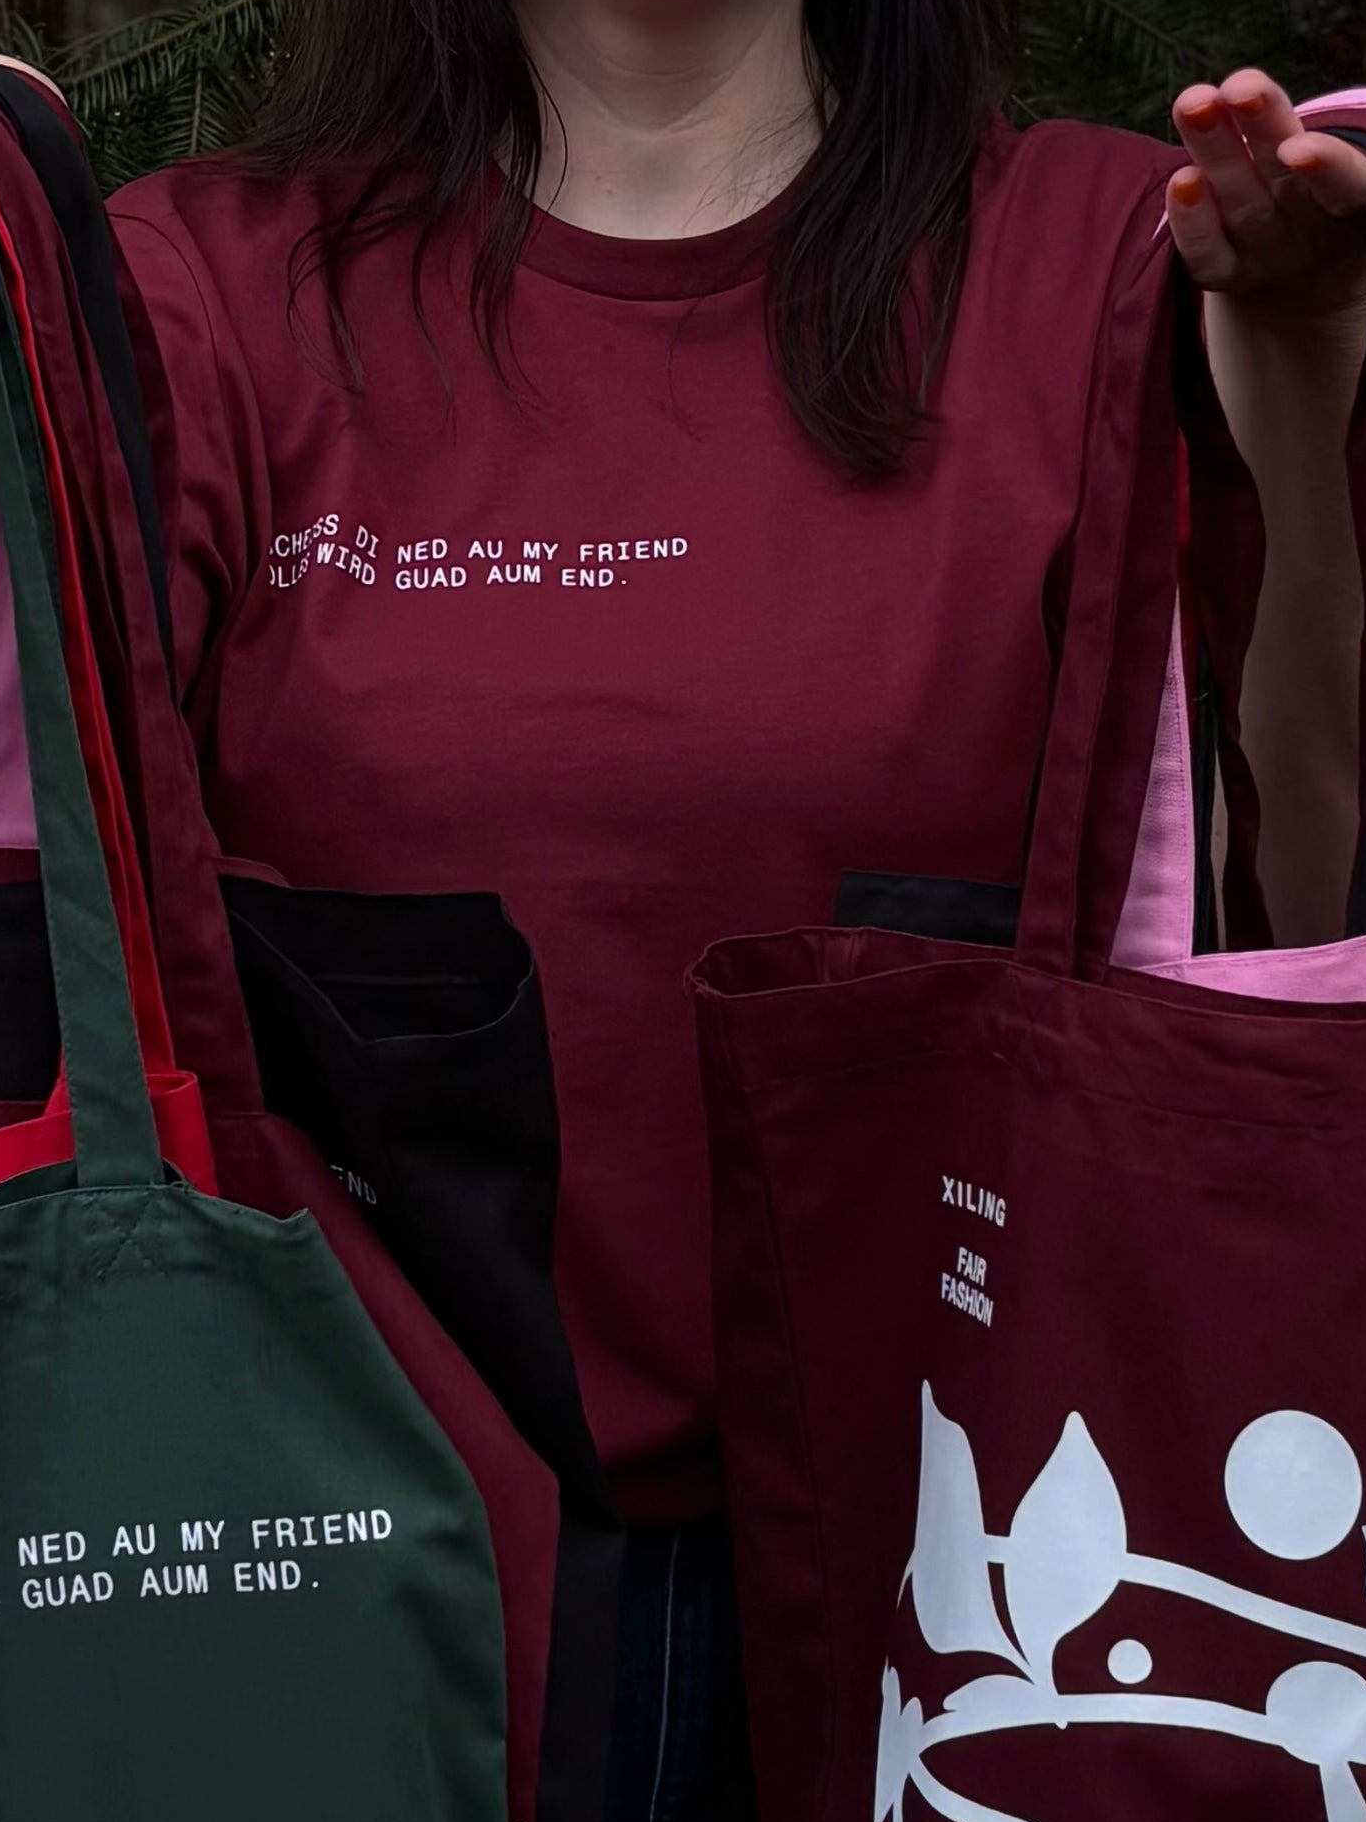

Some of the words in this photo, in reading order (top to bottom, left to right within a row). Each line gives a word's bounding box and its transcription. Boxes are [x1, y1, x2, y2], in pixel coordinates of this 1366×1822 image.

[316, 542, 376, 585] WIRD
[395, 566, 467, 590] GUAD
[486, 564, 541, 585] AUM
[561, 568, 627, 587] END.
[355, 525, 379, 558] DI
[397, 538, 448, 564] NED
[468, 540, 503, 559] AU
[523, 541, 559, 561] MY
[579, 537, 688, 563] FRIEND
[941, 1175, 1006, 1227] XILING
[956, 1246, 987, 1287] FAIR
[941, 1272, 994, 1327] FASHION
[18, 1531, 86, 1567] NED
[112, 1523, 156, 1557] AU
[180, 1519, 225, 1552] MY
[251, 1509, 393, 1550] FRIEND
[21, 1571, 114, 1609] GUAD
[140, 1564, 209, 1598] AUM
[233, 1560, 319, 1592] END.
